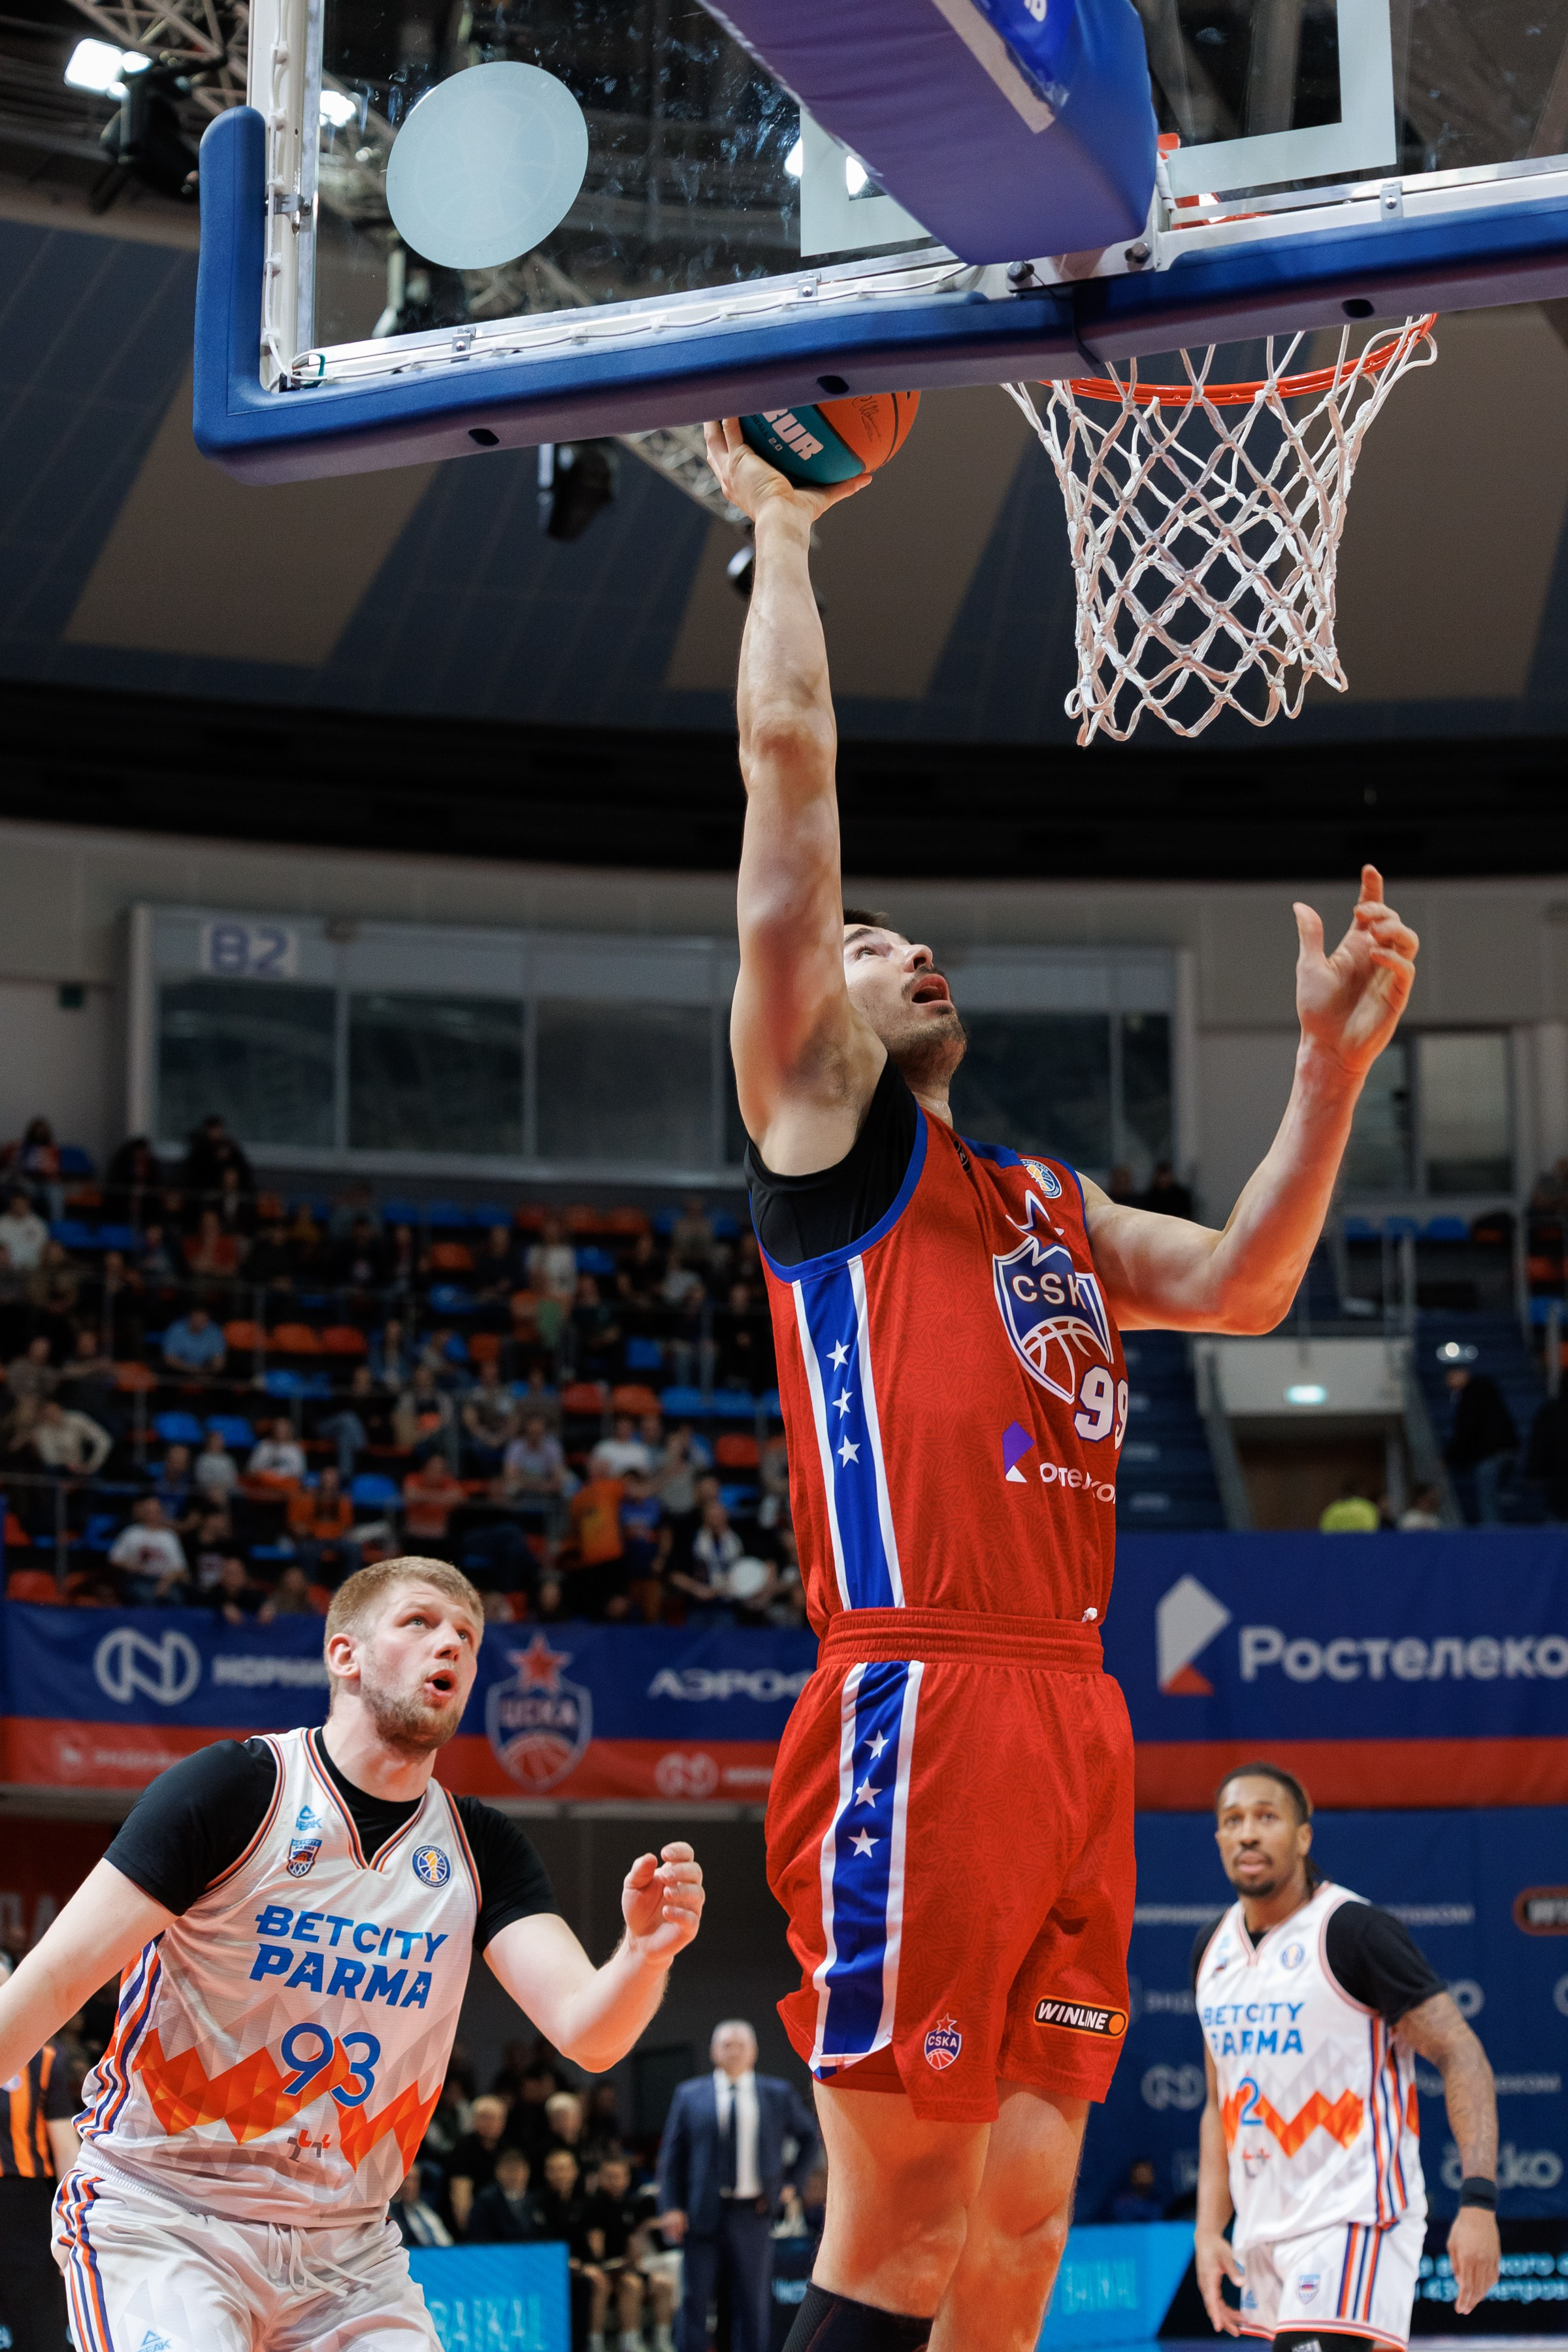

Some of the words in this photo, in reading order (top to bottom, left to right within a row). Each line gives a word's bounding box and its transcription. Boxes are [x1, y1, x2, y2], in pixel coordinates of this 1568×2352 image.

[768, 436, 783, 451] 2.0
[254, 1904, 449, 1963] BETCITY
[249, 1942, 433, 2009] PARMA
[1037, 2002, 1109, 2031] WINLINE
[1203, 2001, 1305, 2027] BETCITY
[927, 2034, 958, 2048] CSKA
[281, 2022, 382, 2108] 93
[1239, 2077, 1264, 2127] 2
